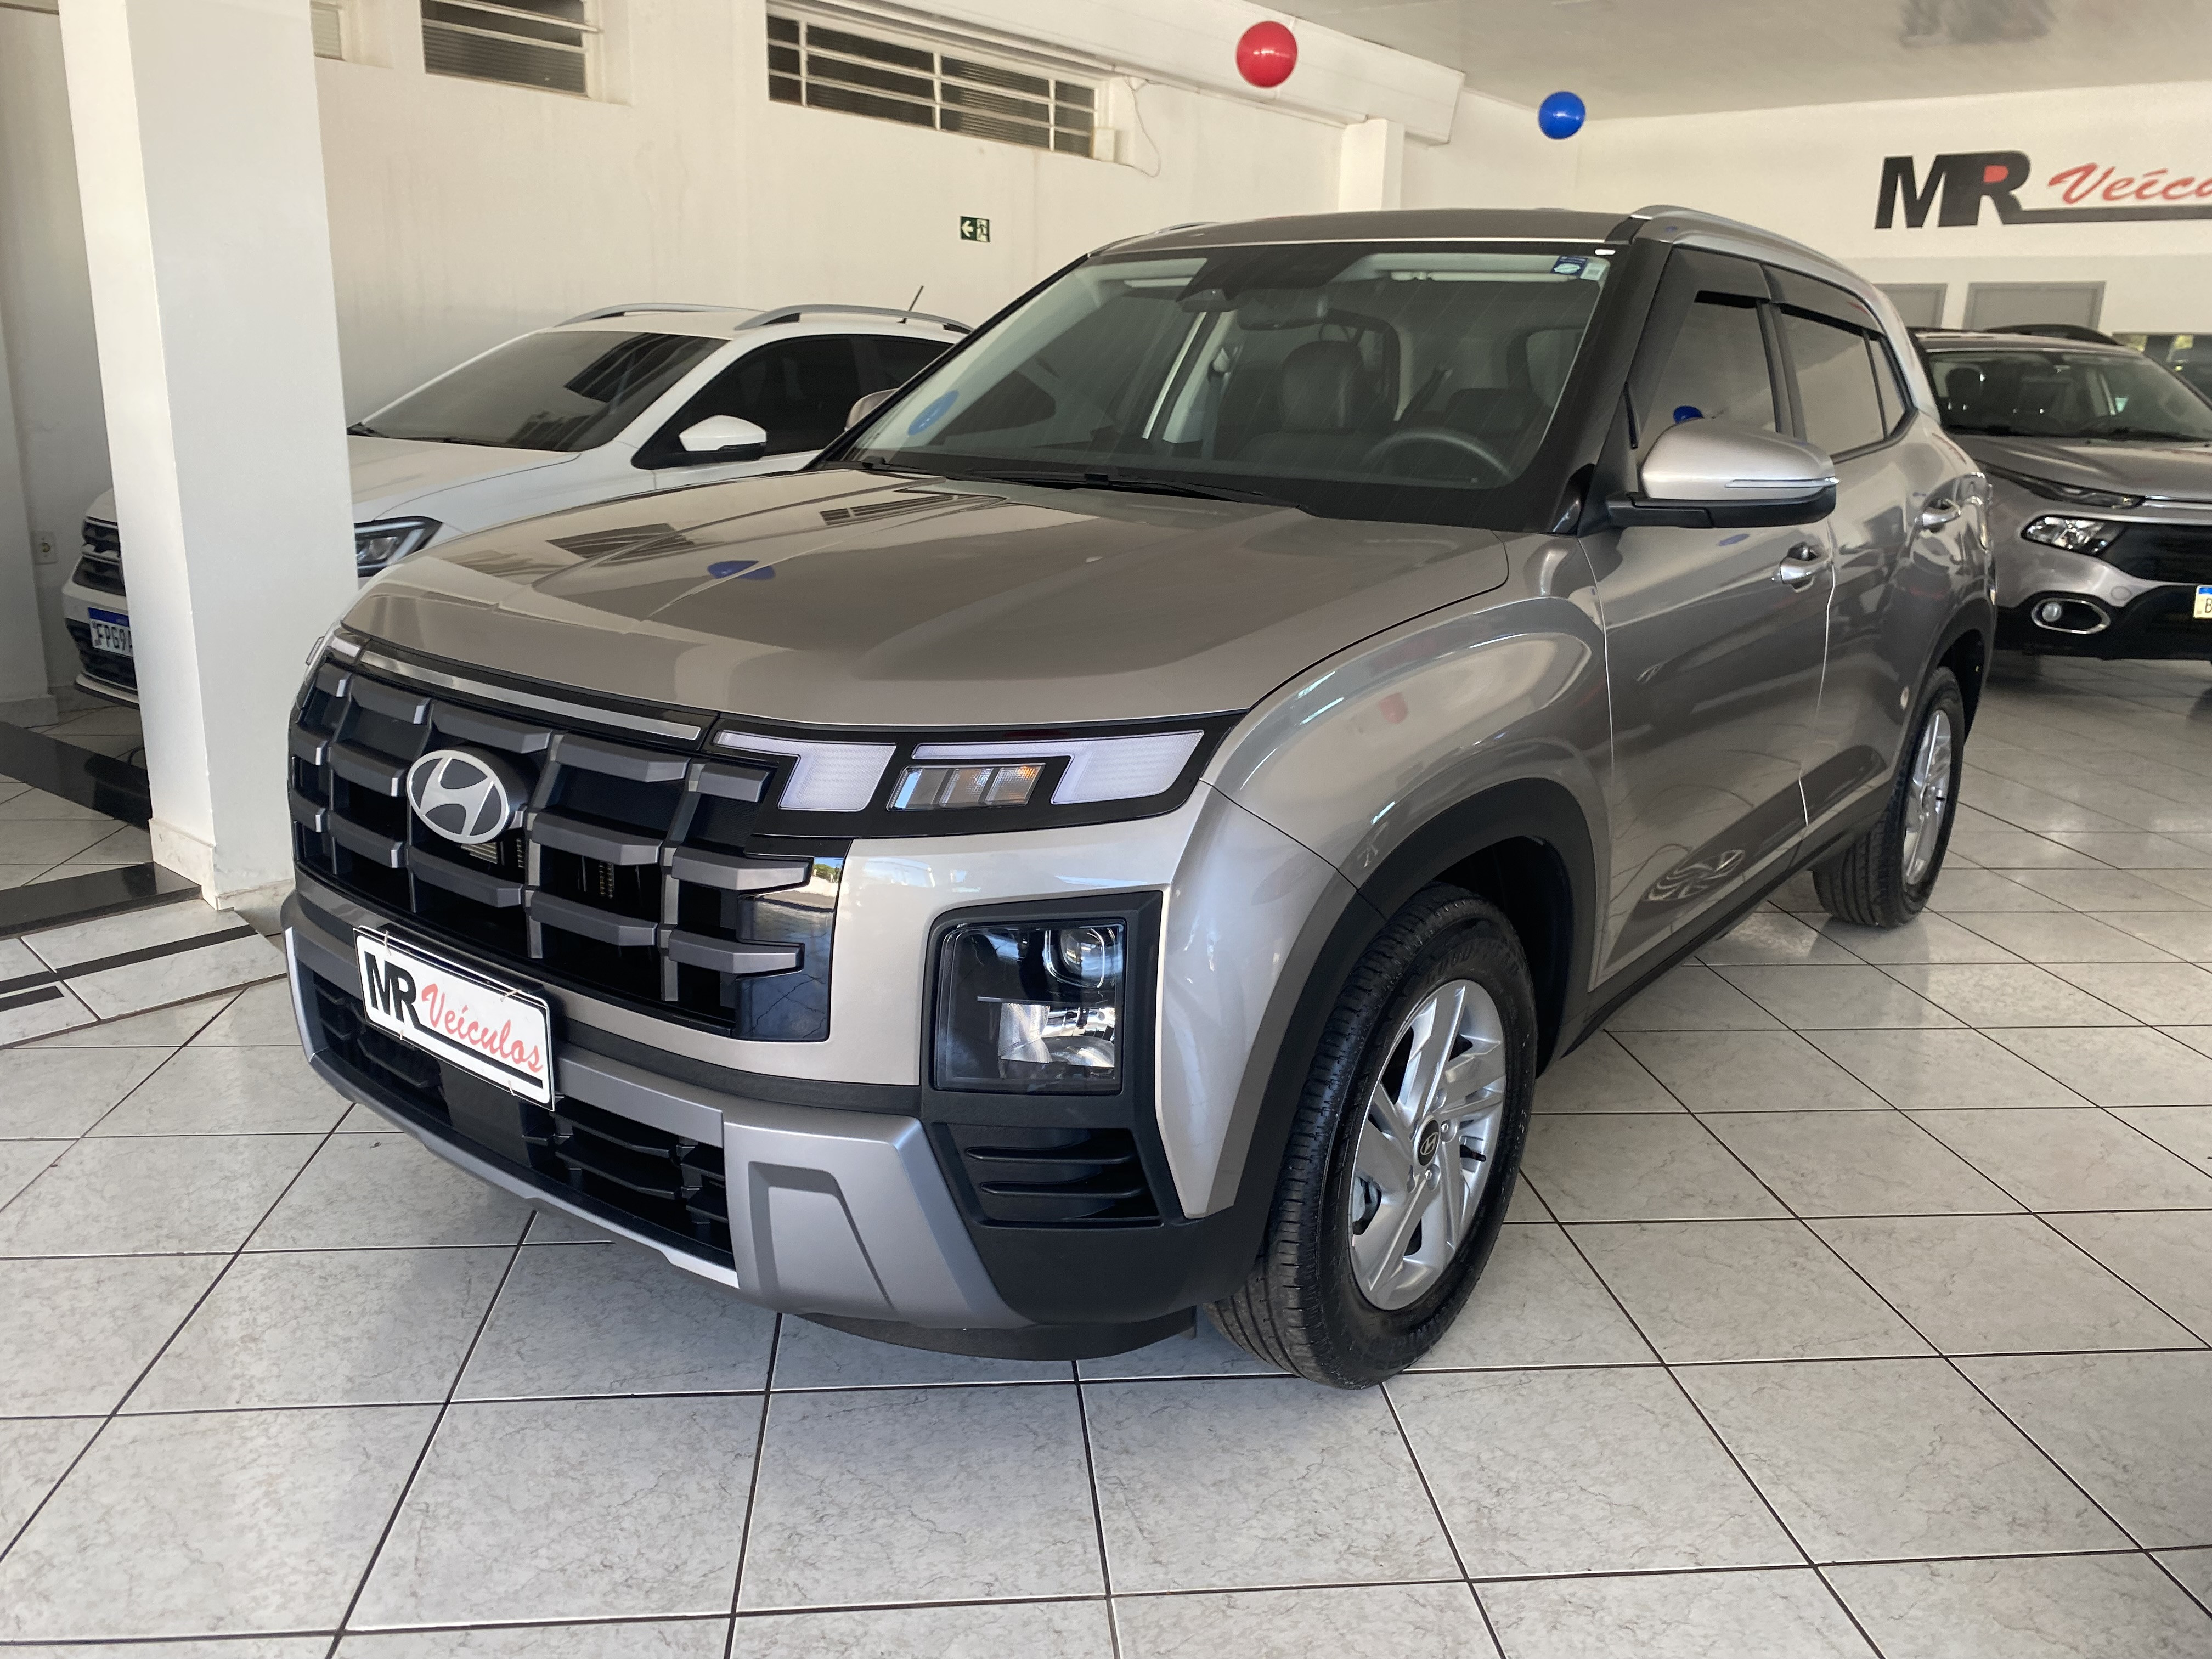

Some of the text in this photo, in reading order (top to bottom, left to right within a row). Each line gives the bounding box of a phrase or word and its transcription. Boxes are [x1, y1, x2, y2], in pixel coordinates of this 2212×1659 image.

[1874, 150, 2031, 229] MR
[364, 950, 543, 1073] MR Veículos
